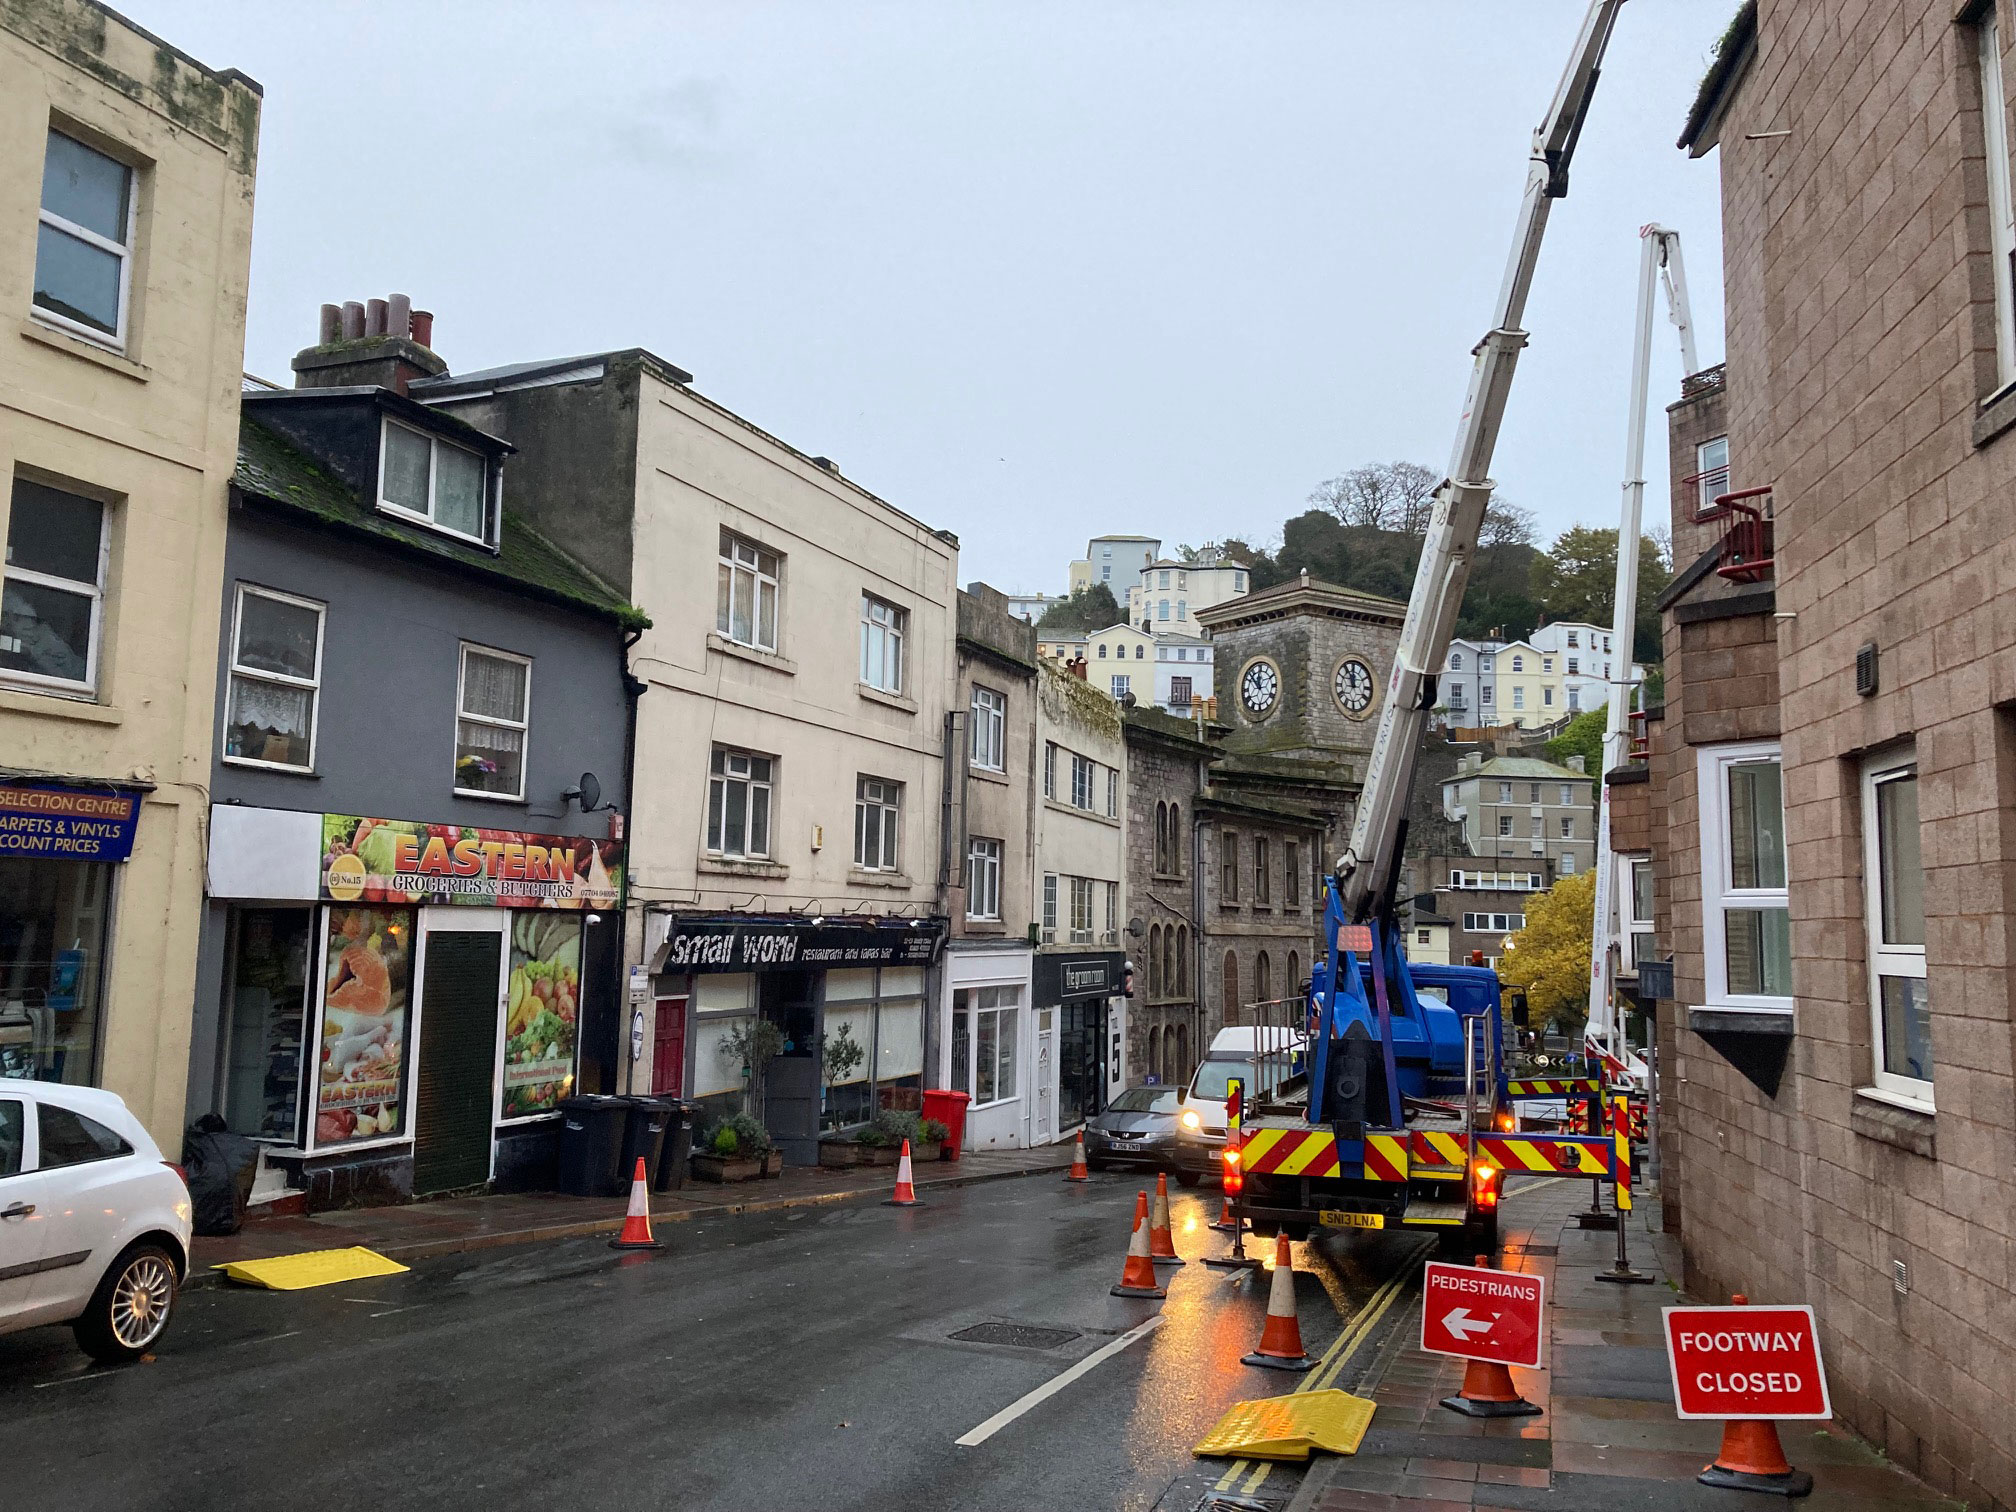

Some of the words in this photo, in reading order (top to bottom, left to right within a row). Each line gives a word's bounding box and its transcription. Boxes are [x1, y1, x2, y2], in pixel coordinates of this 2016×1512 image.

[0, 791, 74, 811] SELECTION
[76, 799, 128, 816] CENTRE
[55, 821, 66, 834] &
[71, 822, 121, 838] VINYLS
[54, 837, 100, 853] PRICES
[394, 833, 576, 883] EASTERN
[393, 875, 482, 894] GROCERIES
[486, 880, 497, 894] &
[501, 882, 573, 897] BUTCHERS
[1327, 1213, 1351, 1225] SN13
[1354, 1215, 1376, 1227] LNA
[1431, 1275, 1536, 1301] PEDESTRIANS
[1680, 1332, 1802, 1352] FOOTWAY
[1696, 1372, 1802, 1393] CLOSED
